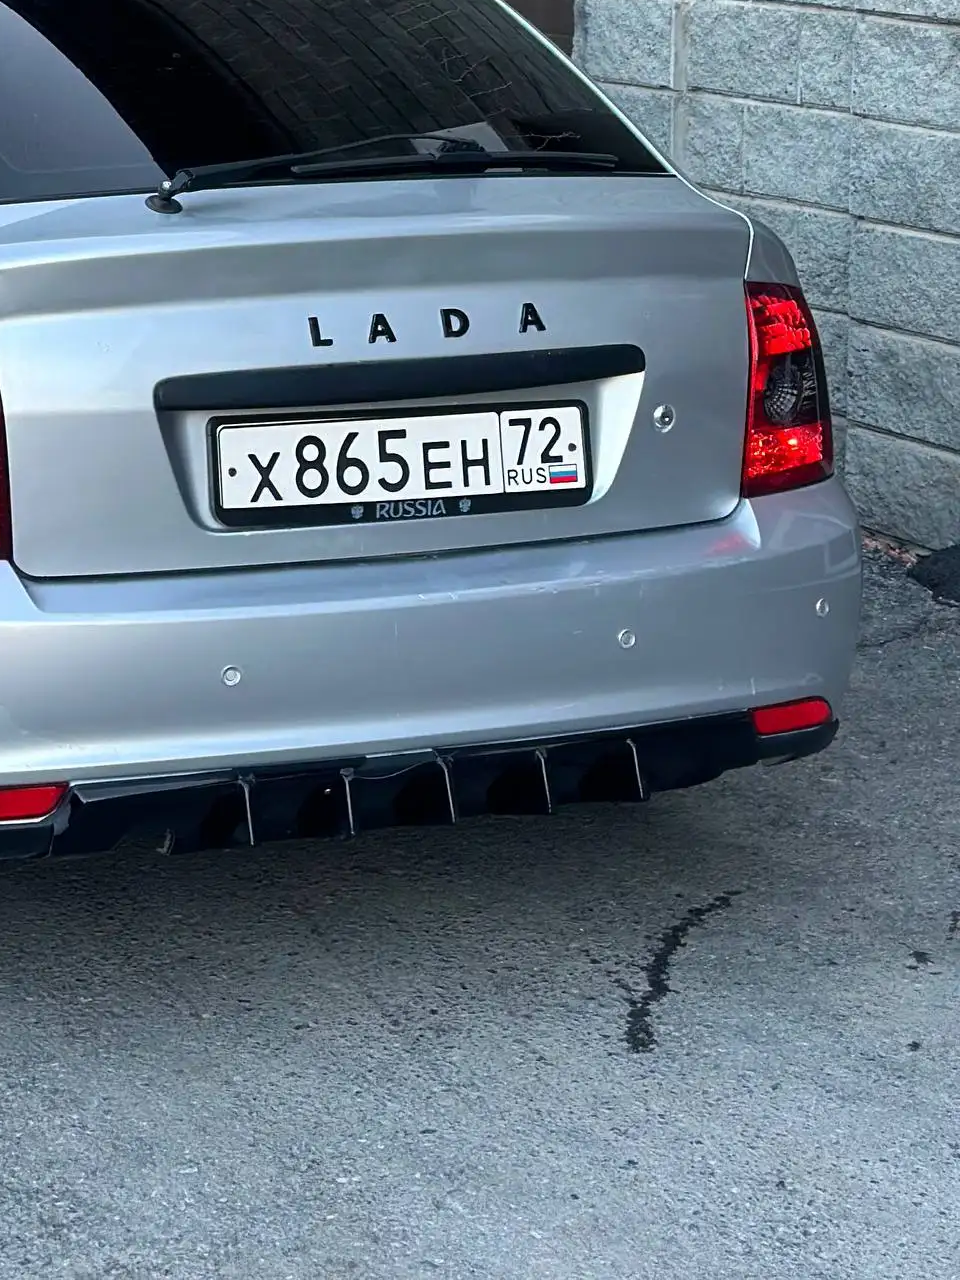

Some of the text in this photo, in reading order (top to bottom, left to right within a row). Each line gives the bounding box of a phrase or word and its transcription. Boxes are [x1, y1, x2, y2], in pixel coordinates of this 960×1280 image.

[307, 302, 547, 348] LADA
[507, 417, 564, 466] 72
[507, 467, 548, 486] RUS
[375, 499, 447, 520] RUSSIA
